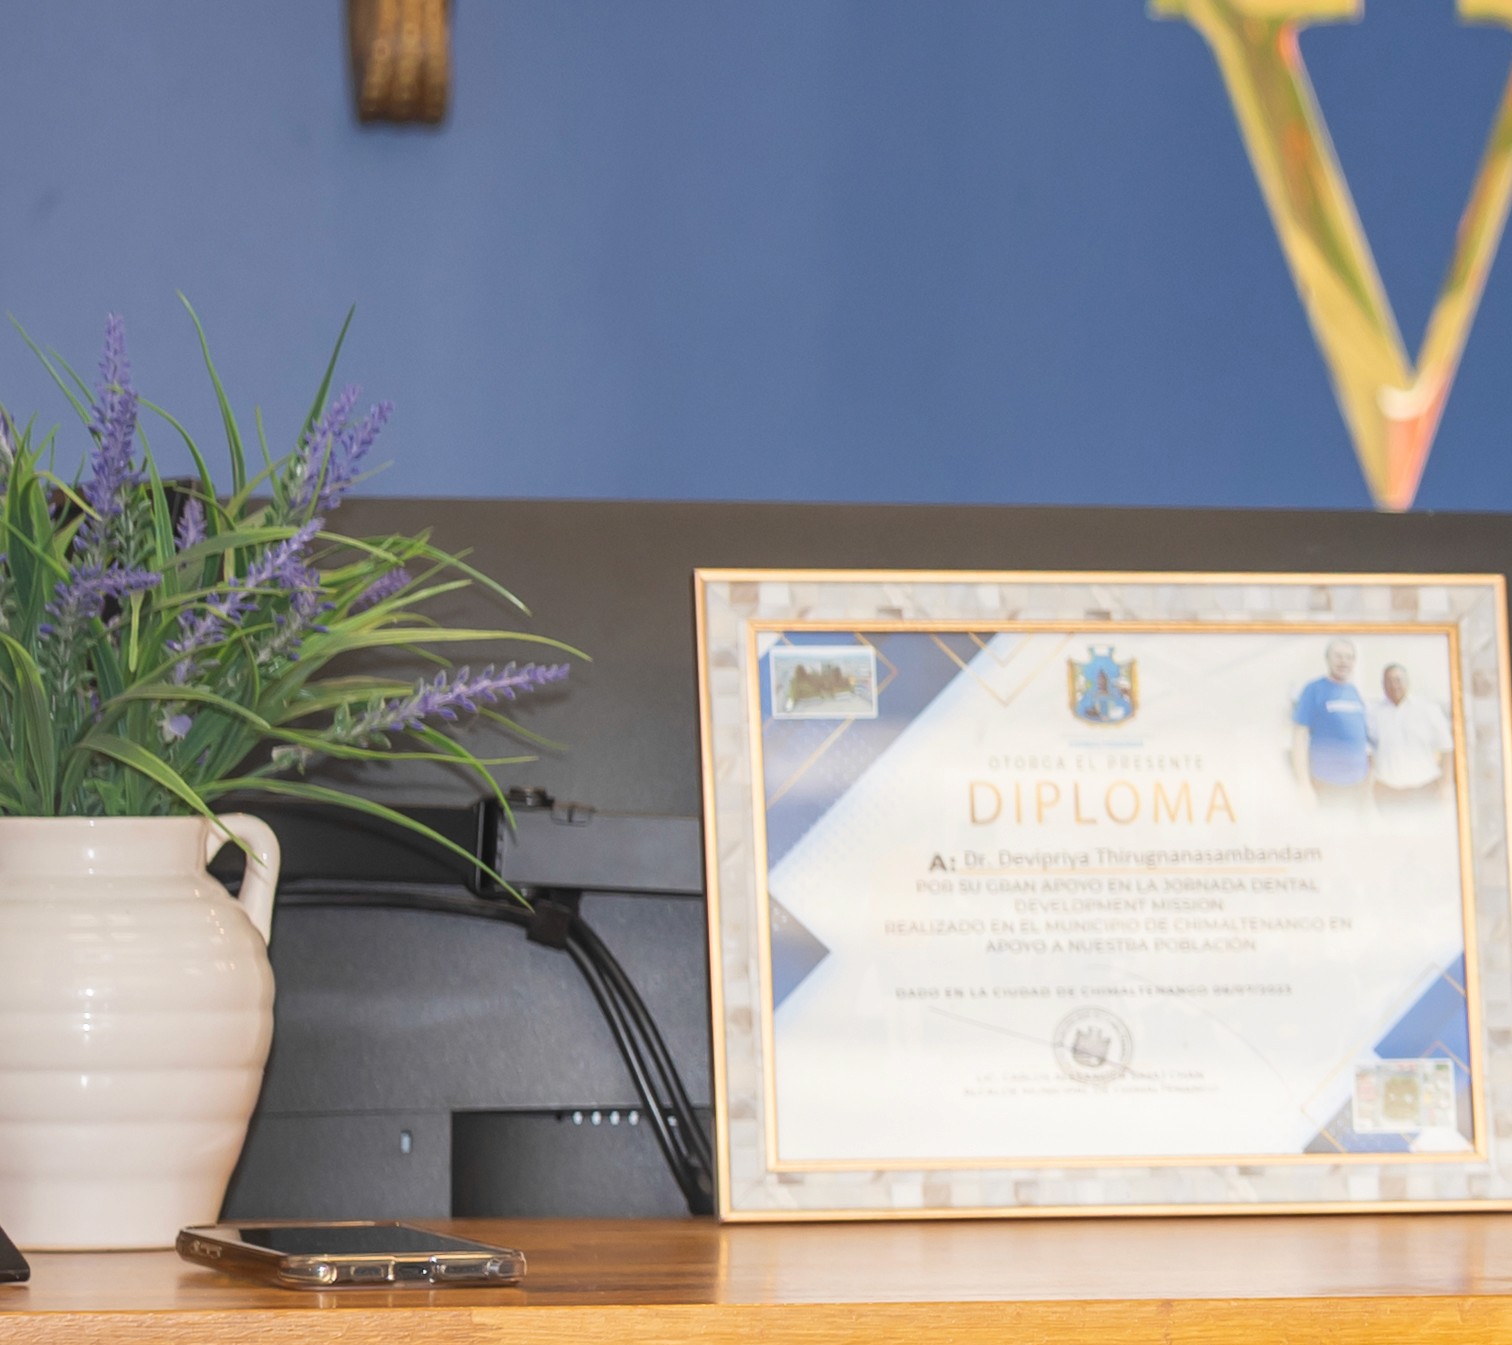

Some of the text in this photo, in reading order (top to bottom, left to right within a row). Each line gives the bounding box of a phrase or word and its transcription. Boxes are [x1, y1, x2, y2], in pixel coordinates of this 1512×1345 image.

[968, 779, 1237, 826] DIPLOMA
[928, 845, 1323, 874] A: Dr. Devipriya Thirugnanasambandam
[959, 879, 981, 895] SU
[1136, 878, 1158, 894] LA
[1251, 877, 1319, 893] DENTAL
[1019, 919, 1040, 935] EL
